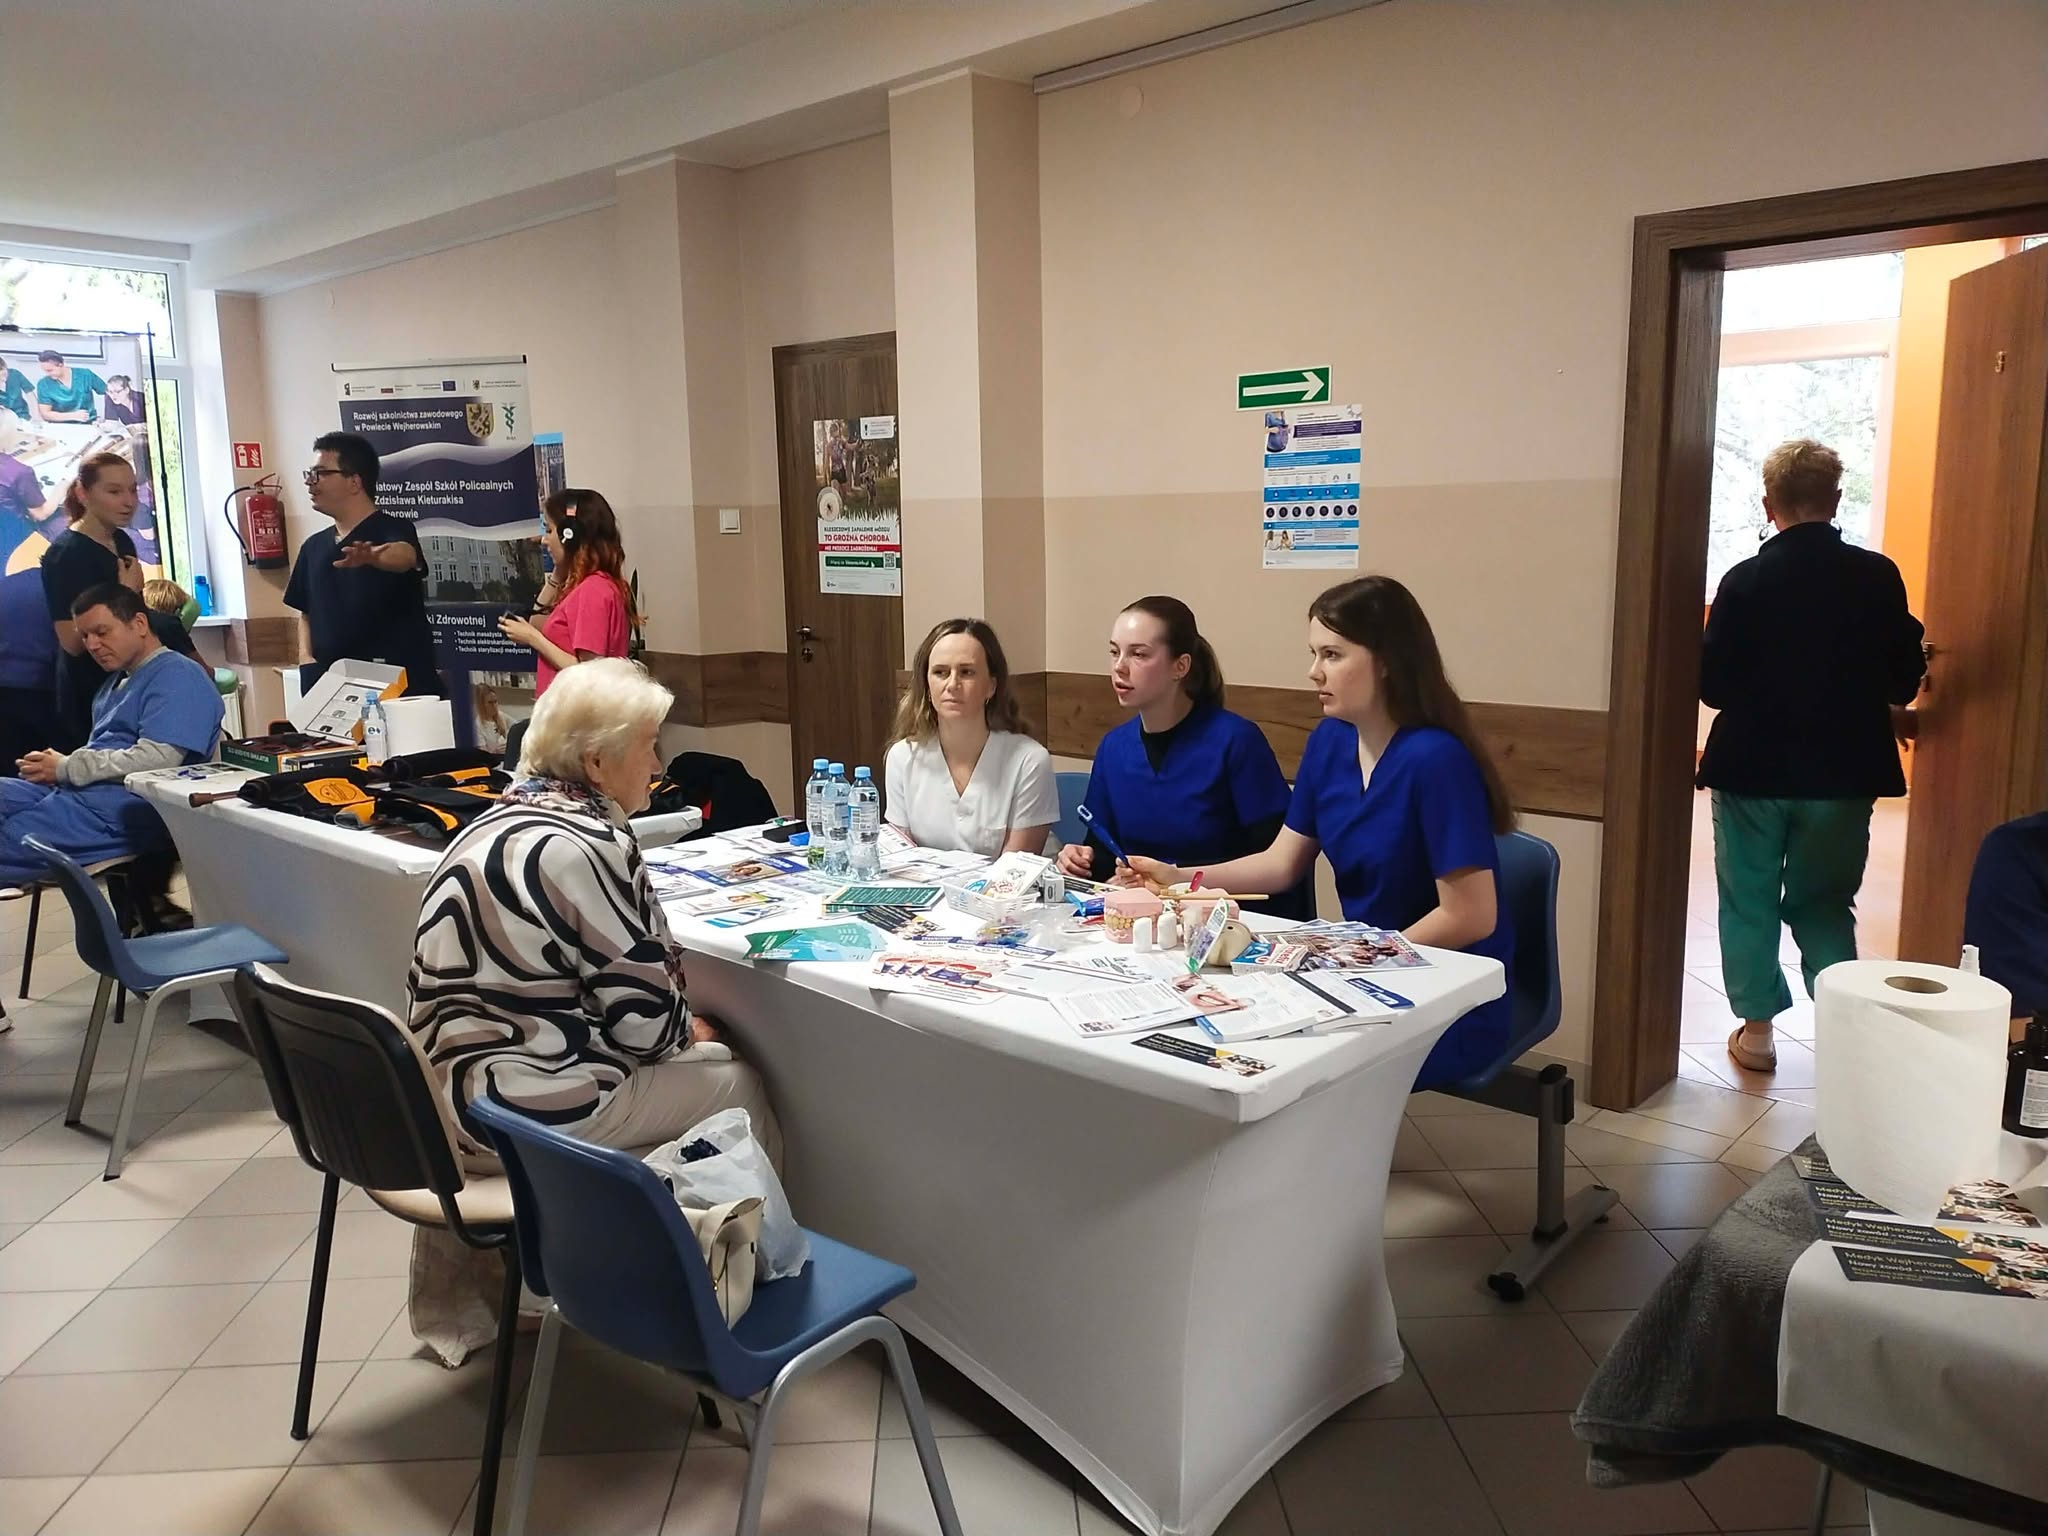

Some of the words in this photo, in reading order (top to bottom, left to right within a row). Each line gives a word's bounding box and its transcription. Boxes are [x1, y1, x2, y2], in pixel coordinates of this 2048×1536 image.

[353, 411, 378, 421] Rozwój
[379, 411, 418, 420] szkolnictwa
[420, 410, 463, 419] zawodowego
[362, 423, 391, 431] Powiecie
[392, 422, 441, 432] Wejherowskim
[376, 482, 402, 494] iatowy
[405, 481, 433, 492] Zespół
[434, 481, 457, 490] Szkół
[460, 480, 513, 492] Policealnych
[374, 495, 416, 505] Zdzisława
[417, 494, 464, 505] Kieturakisa
[436, 614, 486, 627] Zdrowotnej
[1825, 1218, 1862, 1228] Medyk
[1865, 1223, 1930, 1235] Wejherowo
[1827, 1224, 1854, 1233] Nowy
[1844, 1252, 1883, 1262] Medyk
[1886, 1256, 1953, 1269] Wejherowo
[1848, 1260, 1876, 1269] Nowy
